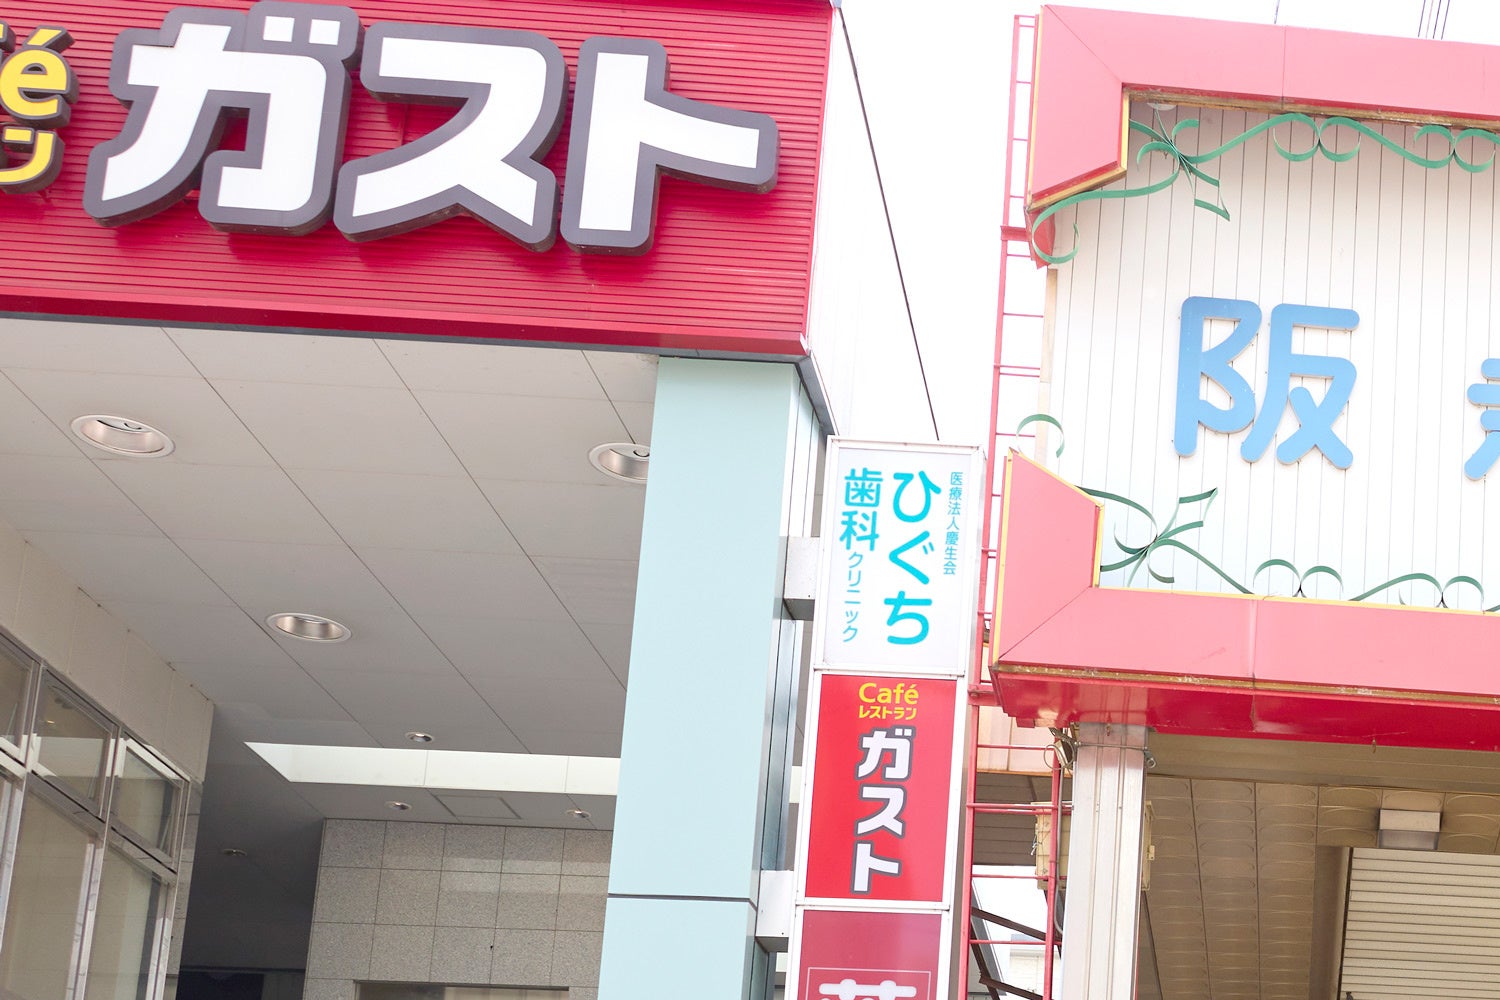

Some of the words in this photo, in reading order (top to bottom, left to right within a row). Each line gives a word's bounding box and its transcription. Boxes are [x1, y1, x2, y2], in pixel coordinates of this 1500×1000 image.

[95, 10, 768, 242] ガスト
[884, 469, 941, 645] ひぐち
[941, 471, 963, 576] 医療法人慶生会
[858, 682, 919, 705] Café
[858, 706, 918, 720] レストラン
[854, 727, 915, 894] ガスト
